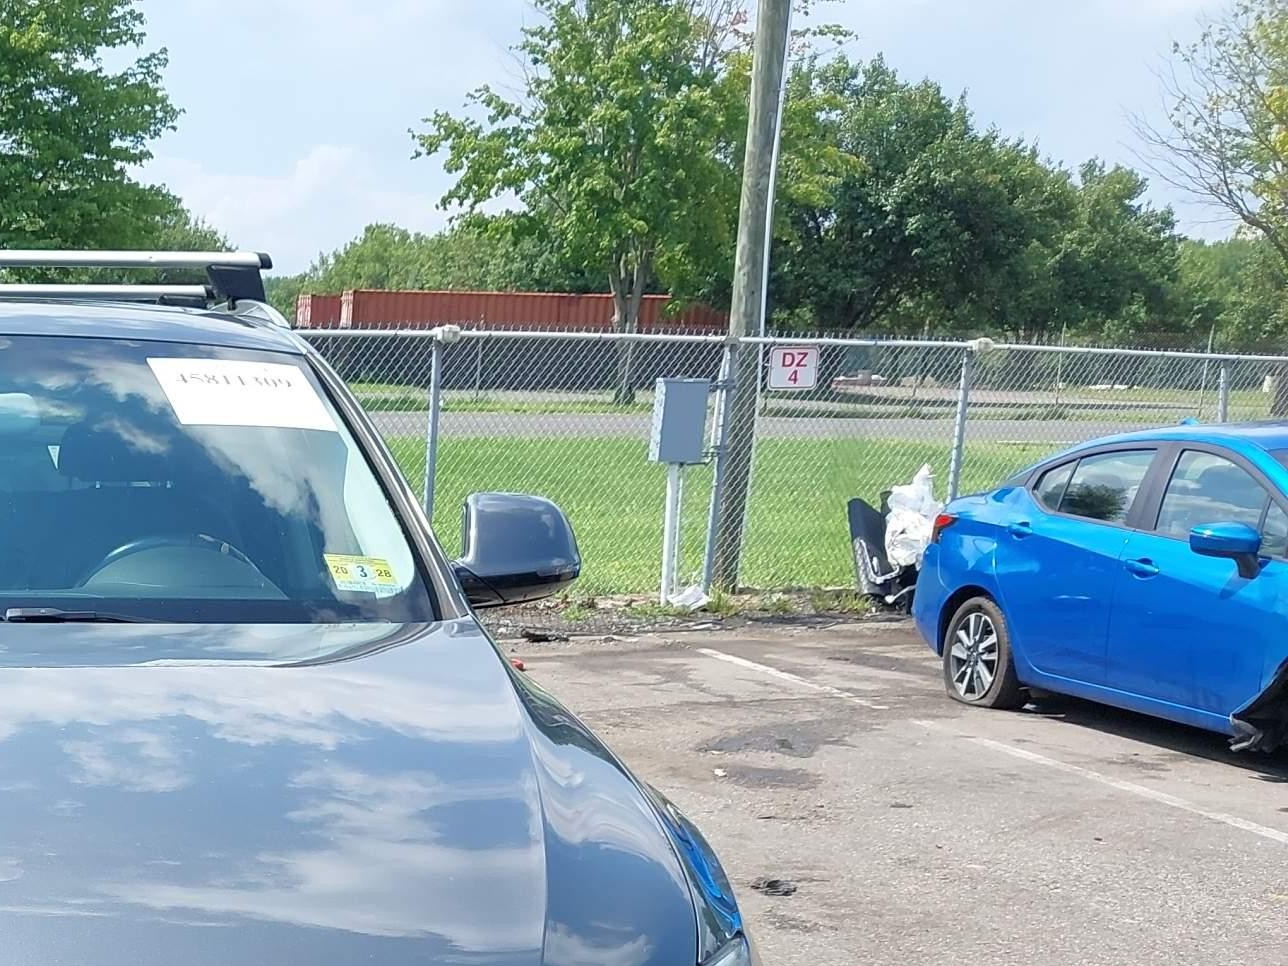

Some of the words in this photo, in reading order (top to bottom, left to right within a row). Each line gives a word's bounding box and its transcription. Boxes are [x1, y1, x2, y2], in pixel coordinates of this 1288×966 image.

[781, 352, 809, 368] DZ
[787, 369, 799, 385] 4
[333, 565, 349, 575] 20
[356, 565, 368, 578] 3
[375, 568, 392, 578] 28
